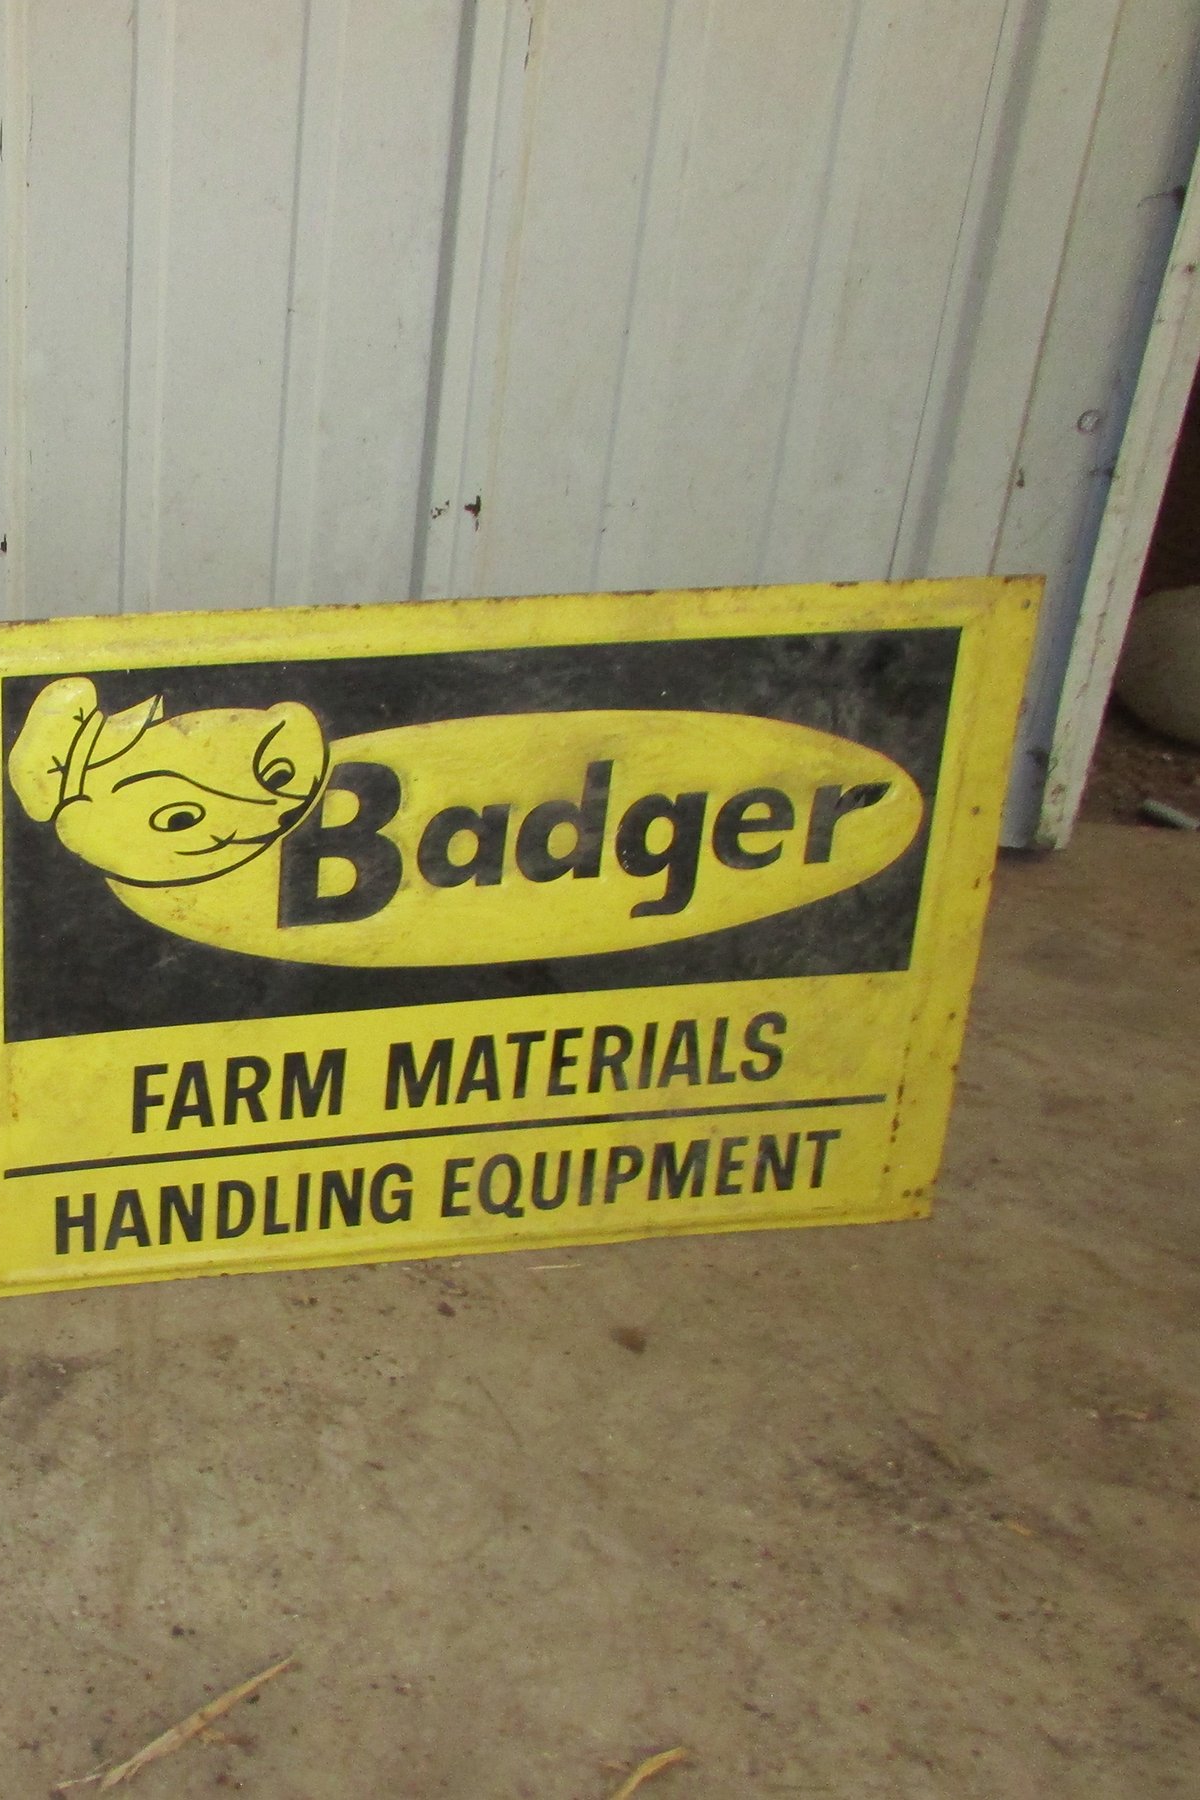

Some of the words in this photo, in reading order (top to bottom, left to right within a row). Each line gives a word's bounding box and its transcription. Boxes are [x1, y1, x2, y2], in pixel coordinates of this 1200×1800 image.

[277, 760, 890, 929] Badger
[131, 1048, 346, 1134] FARM
[385, 1012, 788, 1109] MATERIALS
[54, 1167, 412, 1256] HANDLING
[441, 1129, 841, 1219] EQUIPMENT
